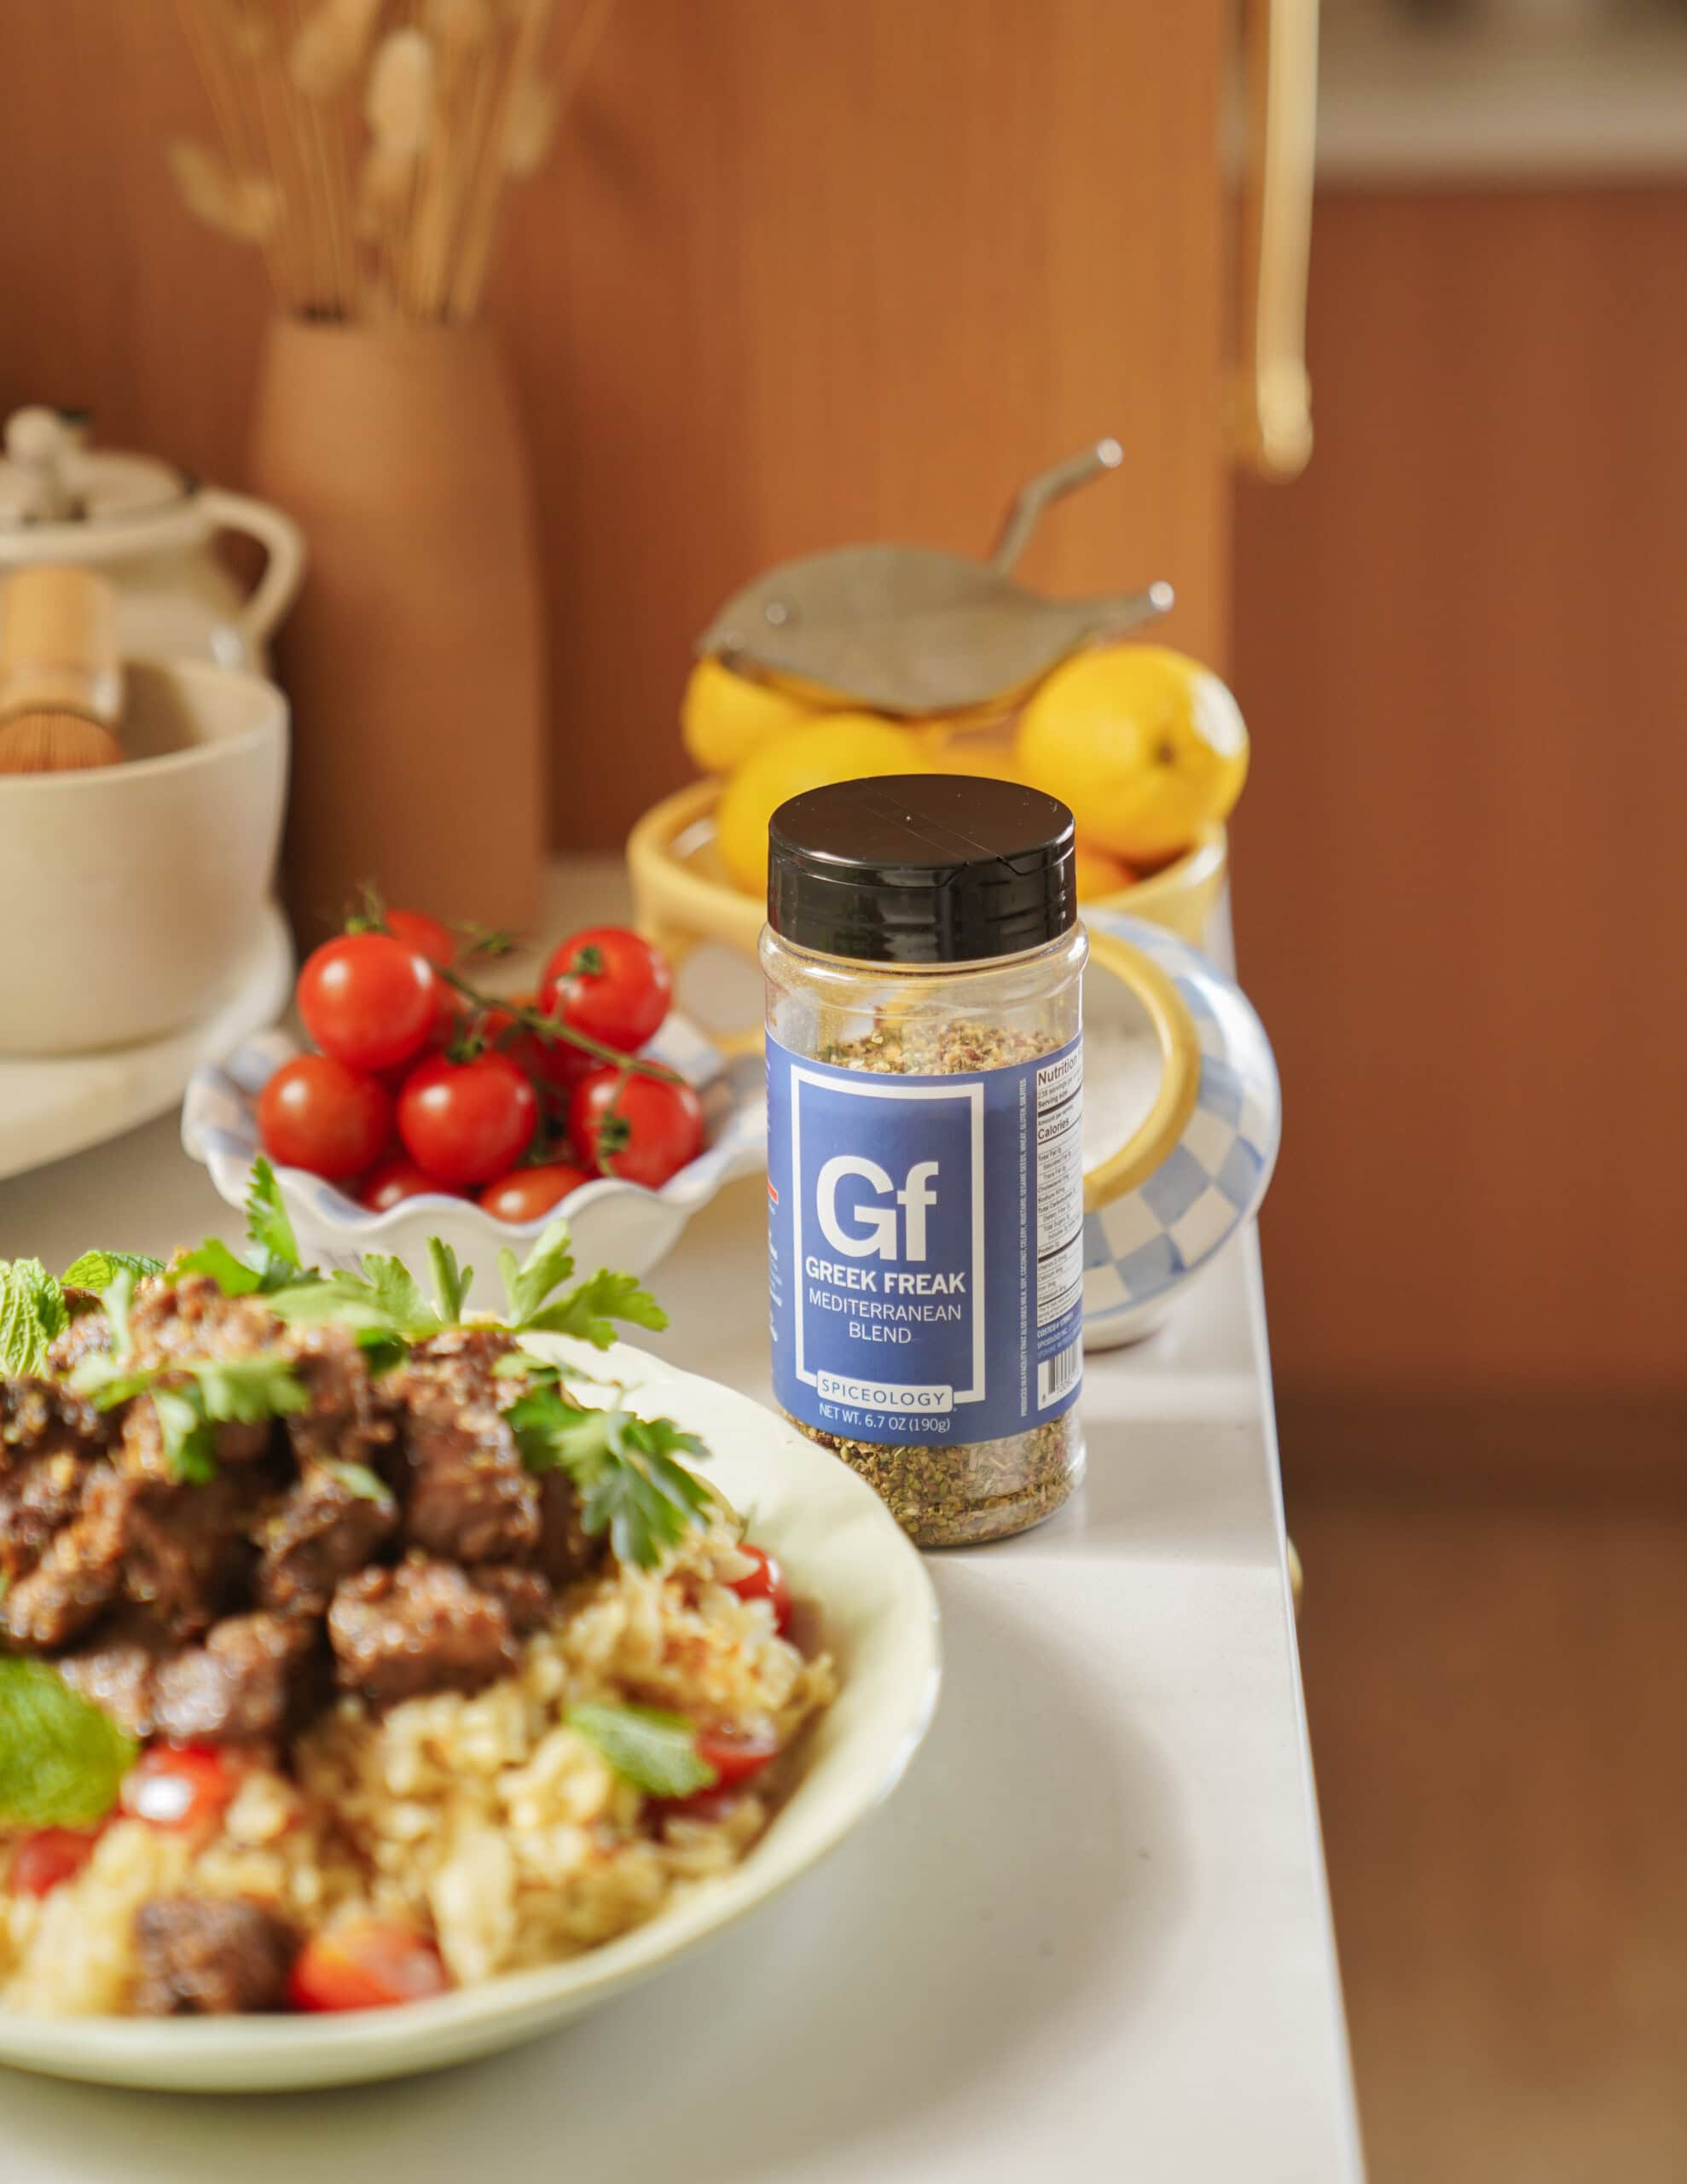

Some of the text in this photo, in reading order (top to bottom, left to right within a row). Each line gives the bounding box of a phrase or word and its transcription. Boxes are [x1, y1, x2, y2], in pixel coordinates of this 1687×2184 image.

[1038, 1118, 1070, 1140] Calories
[816, 1155, 939, 1262] Gf
[805, 1256, 878, 1293] GREEK
[884, 1272, 966, 1296] FREAK
[809, 1288, 962, 1322] MEDITERRANEAN
[849, 1321, 912, 1344] BLEND
[821, 1379, 946, 1407] SPICEOLOGY
[819, 1402, 951, 1434] NET WT. 6.7 OZ (190g)
